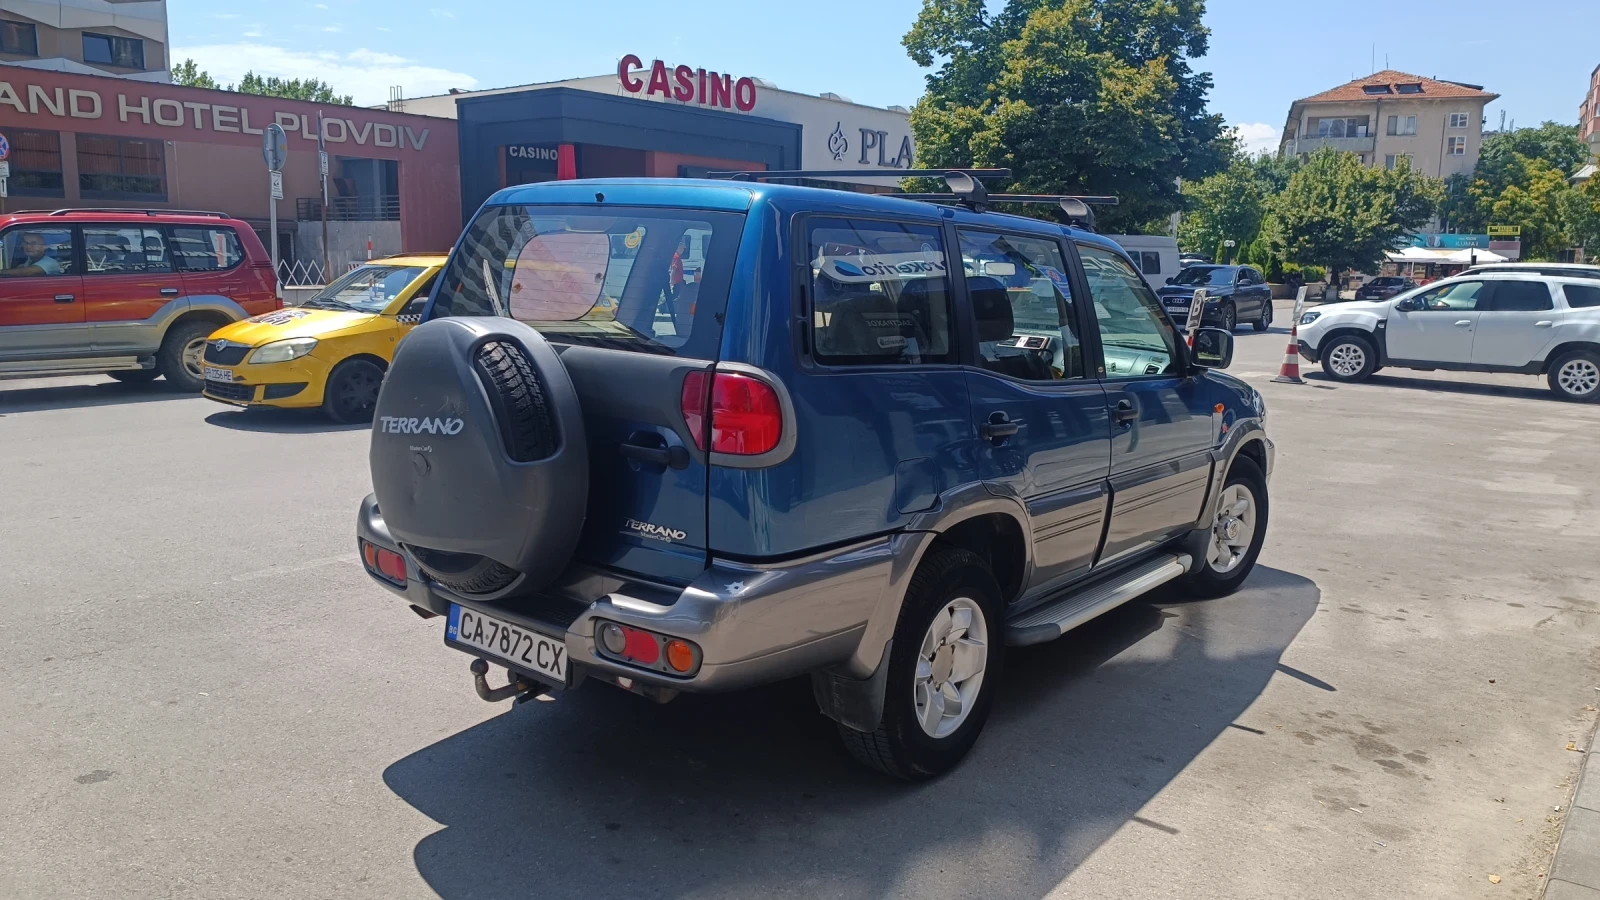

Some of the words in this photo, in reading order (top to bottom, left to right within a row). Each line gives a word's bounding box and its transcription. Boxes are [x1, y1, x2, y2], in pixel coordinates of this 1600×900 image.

[618, 54, 756, 111] CASINO
[0, 82, 102, 119] AND
[118, 94, 263, 135] HOTEL
[275, 111, 430, 151] PLOVDIV
[509, 145, 558, 161] CASINO
[380, 416, 464, 435] TERRANO
[624, 517, 687, 540] TERRANO
[448, 625, 458, 635] BG
